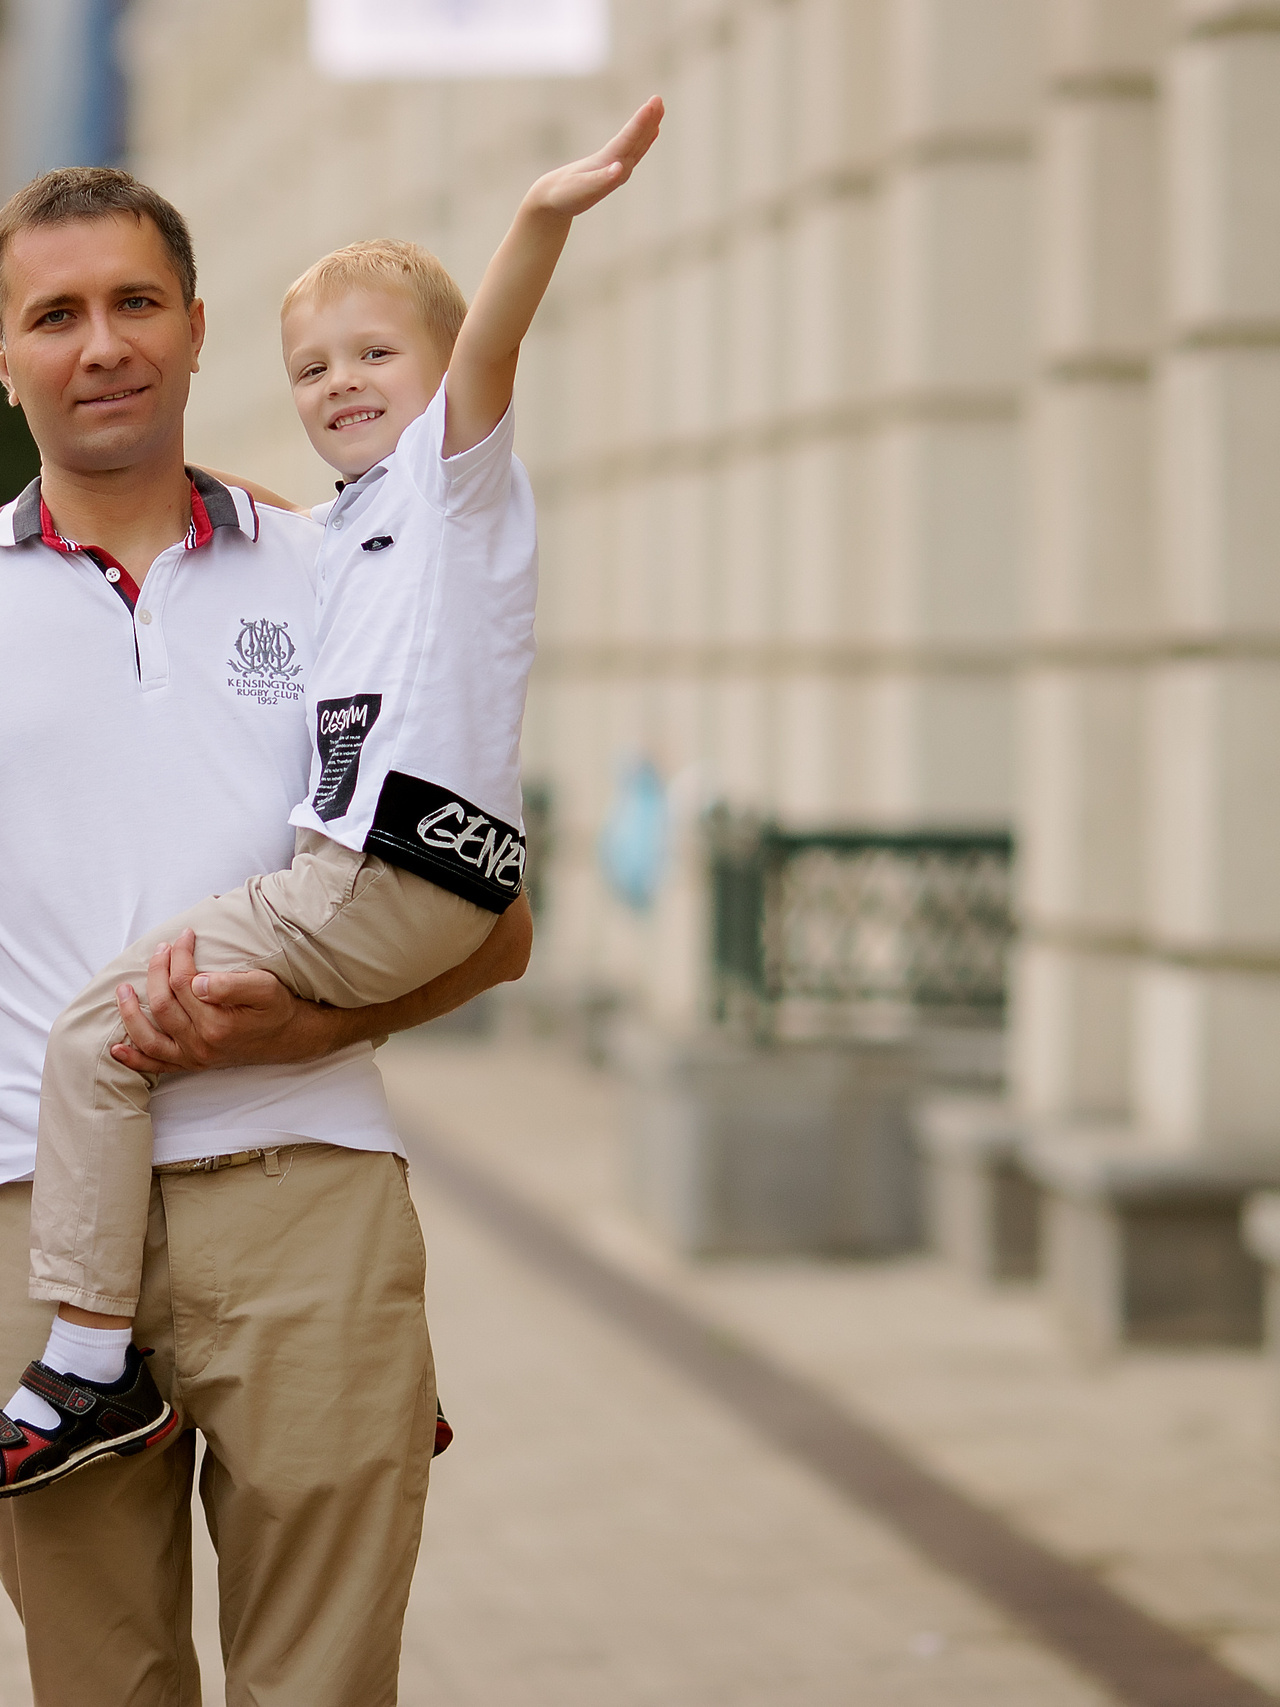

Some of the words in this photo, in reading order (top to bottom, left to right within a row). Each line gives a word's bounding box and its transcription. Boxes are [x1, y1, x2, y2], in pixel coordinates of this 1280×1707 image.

[227, 678, 305, 693] KENSINGTON
[237, 688, 269, 697] RUGBY
[274, 690, 299, 701] CLUB
[257, 696, 278, 705] 1952
